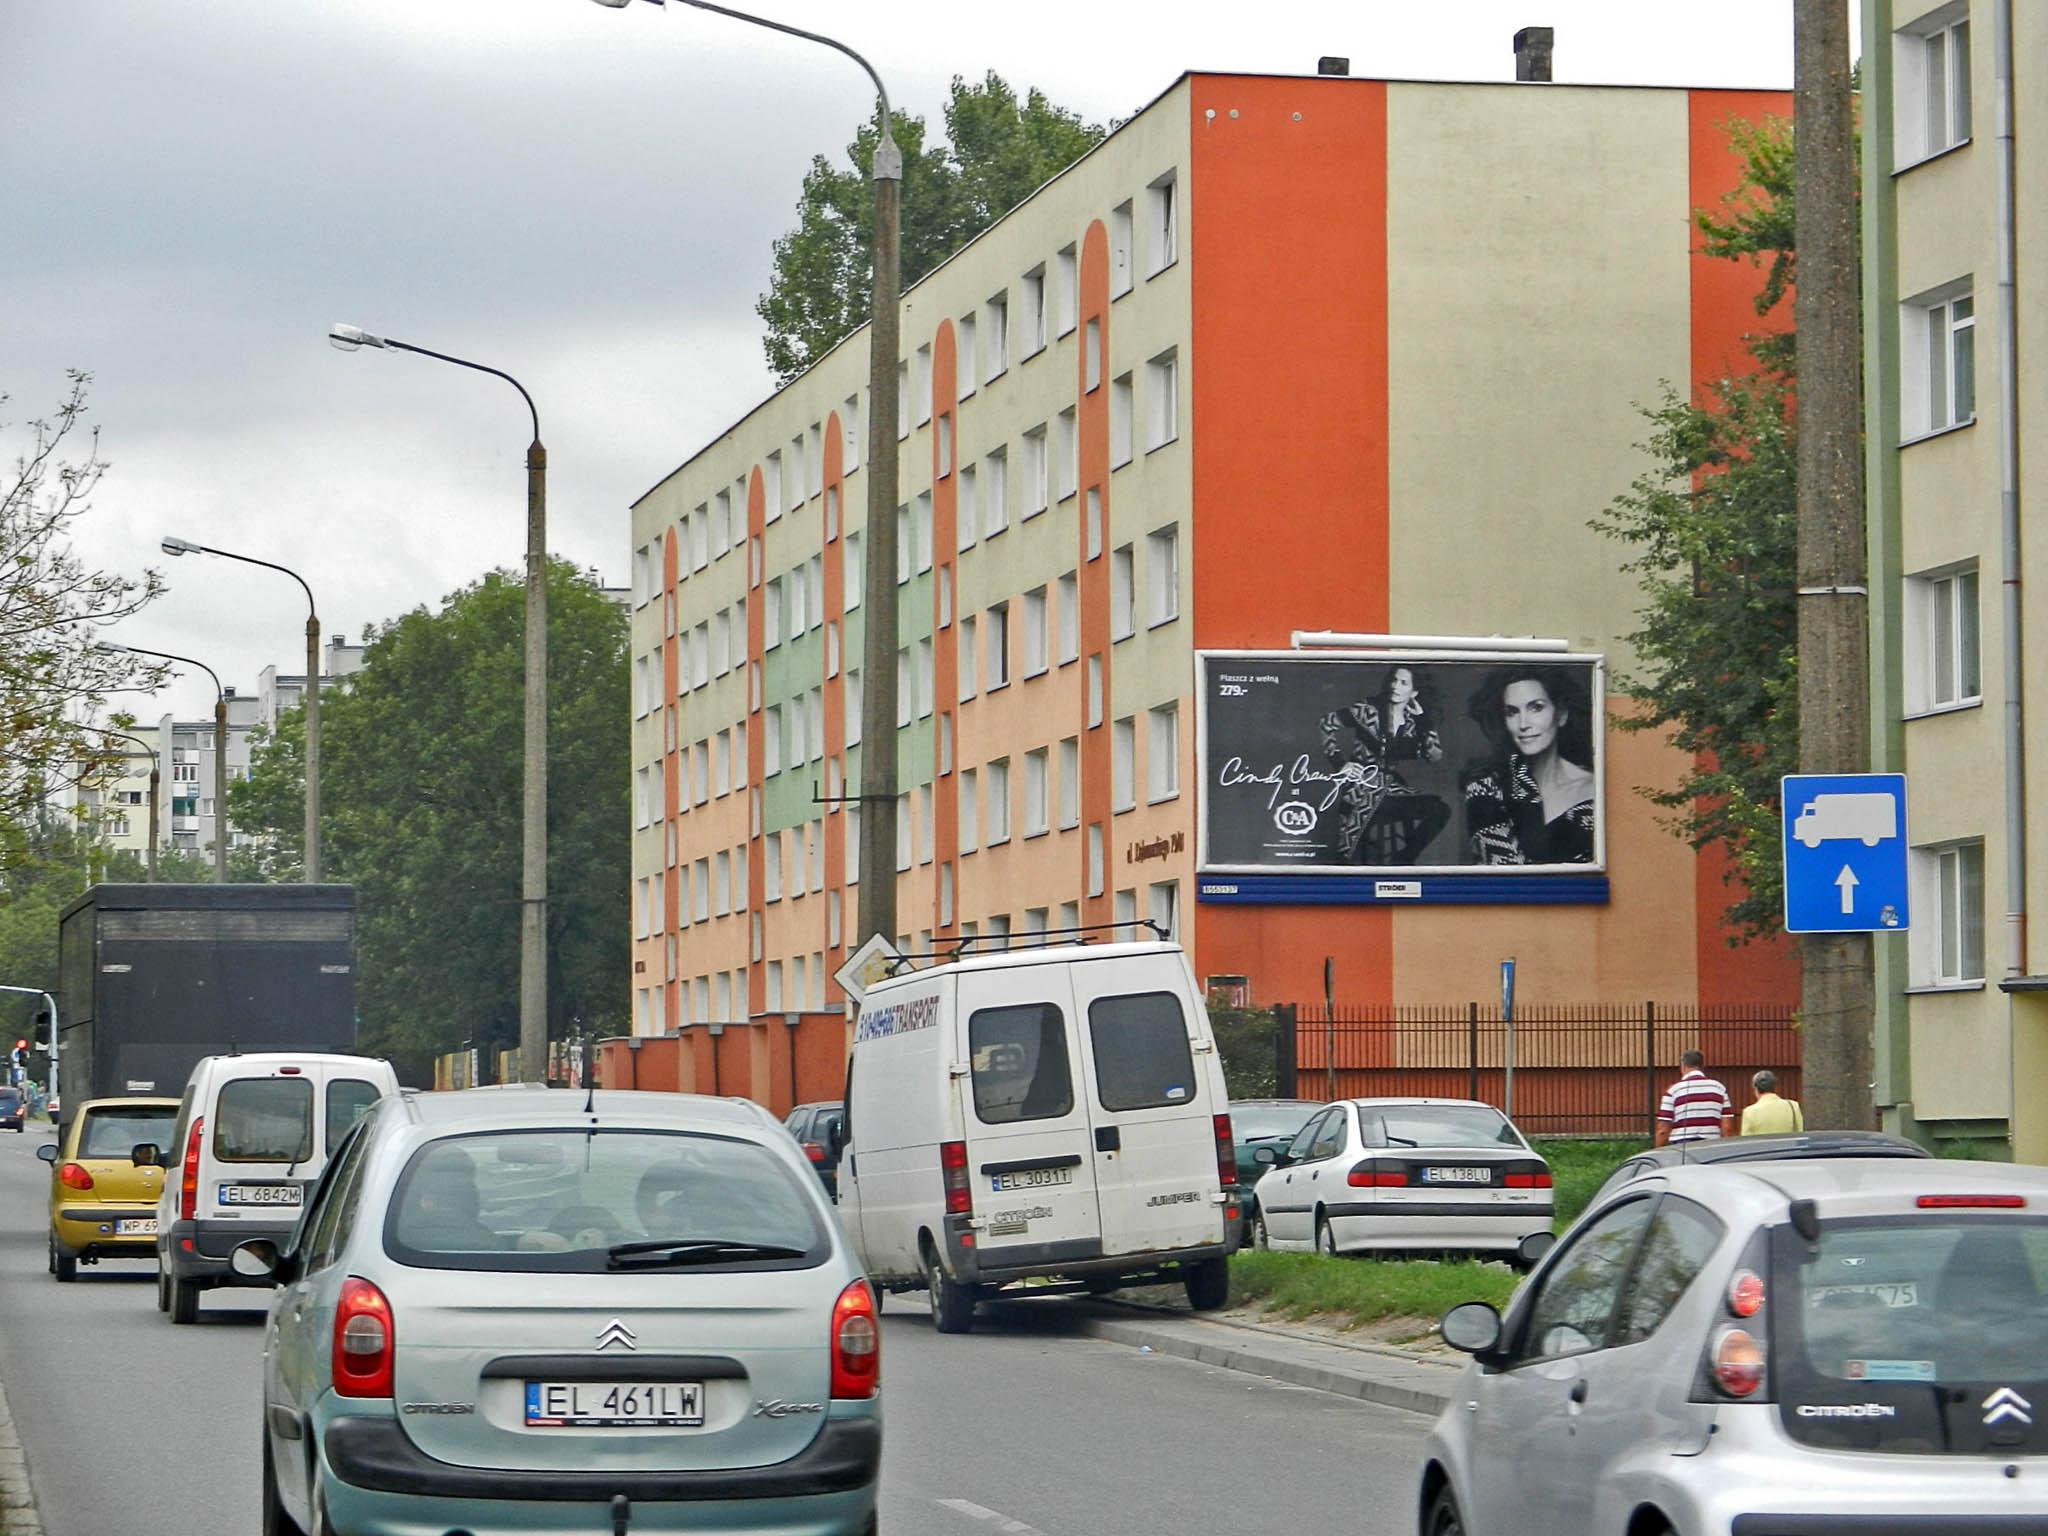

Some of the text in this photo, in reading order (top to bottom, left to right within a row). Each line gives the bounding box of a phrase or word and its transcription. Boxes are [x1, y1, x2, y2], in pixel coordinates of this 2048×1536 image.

[1219, 685, 1248, 696] 279.-
[1220, 757, 1284, 810] Cindy
[1281, 810, 1310, 826] C&A
[894, 995, 940, 1034] TRANSPORT
[1001, 1168, 1069, 1188] EL 3031T
[1428, 1167, 1489, 1181] EL 138LU
[228, 1189, 300, 1201] EL 6842M
[1147, 1191, 1201, 1207] JUMPER
[123, 1221, 138, 1232] WP
[547, 1386, 698, 1416] EL 461LW
